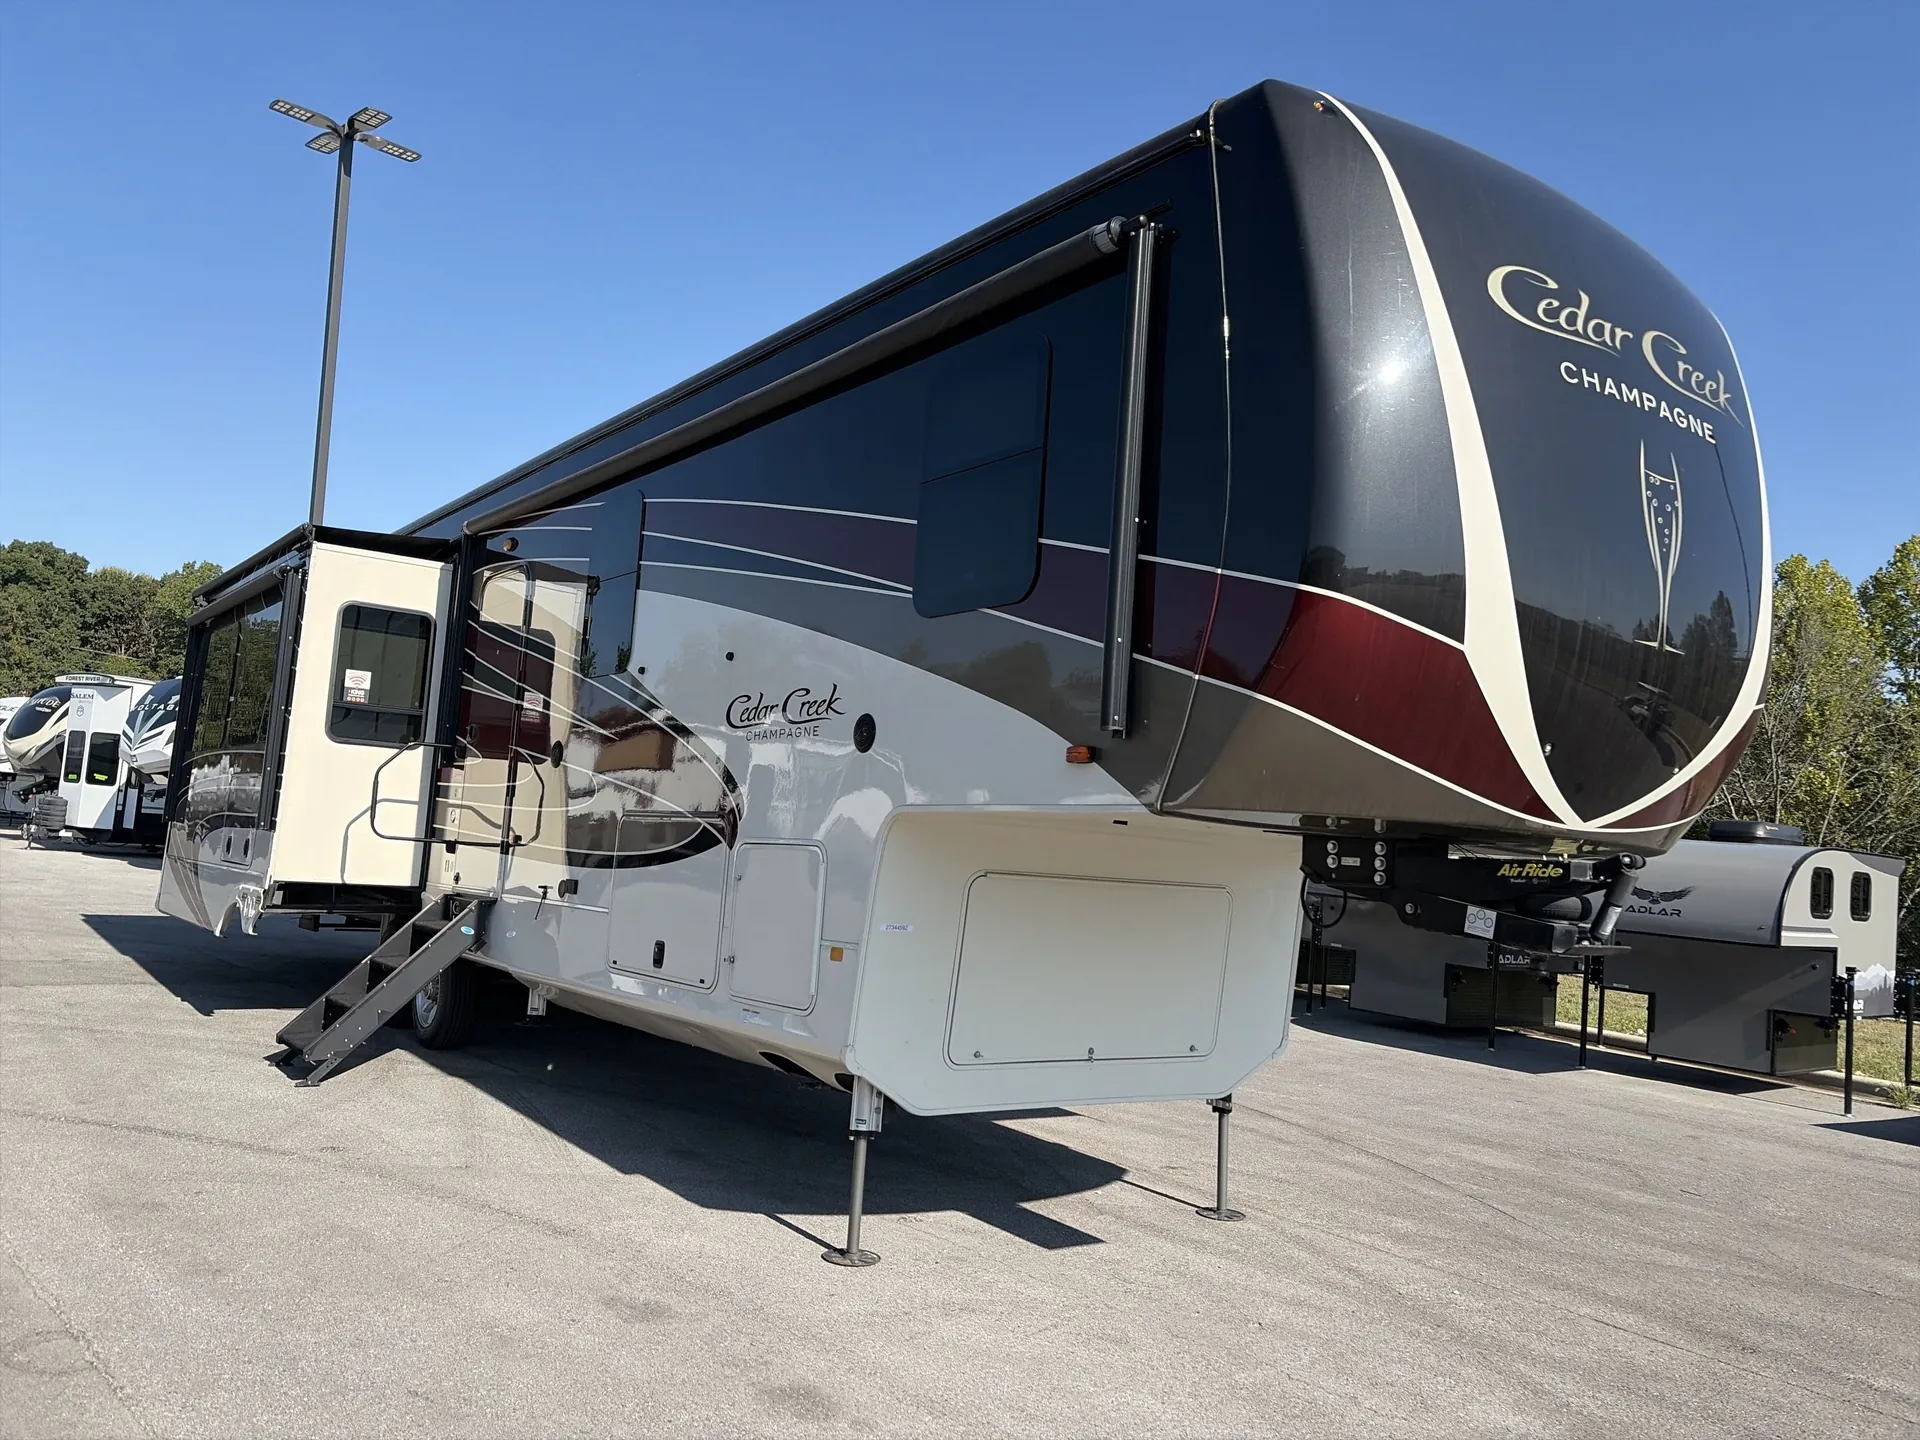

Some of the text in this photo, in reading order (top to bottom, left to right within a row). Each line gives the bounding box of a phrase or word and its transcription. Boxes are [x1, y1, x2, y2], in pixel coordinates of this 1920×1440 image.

[1487, 265, 1745, 428] Cedar Creek
[1559, 361, 1717, 444] CHAMPAGNE
[70, 692, 94, 700] SALEM
[725, 683, 847, 729] Cedar Creek
[745, 725, 820, 741] CHAMPAGNE
[1624, 904, 1682, 918] ADLAR
[1498, 954, 1531, 965] ADLAR
